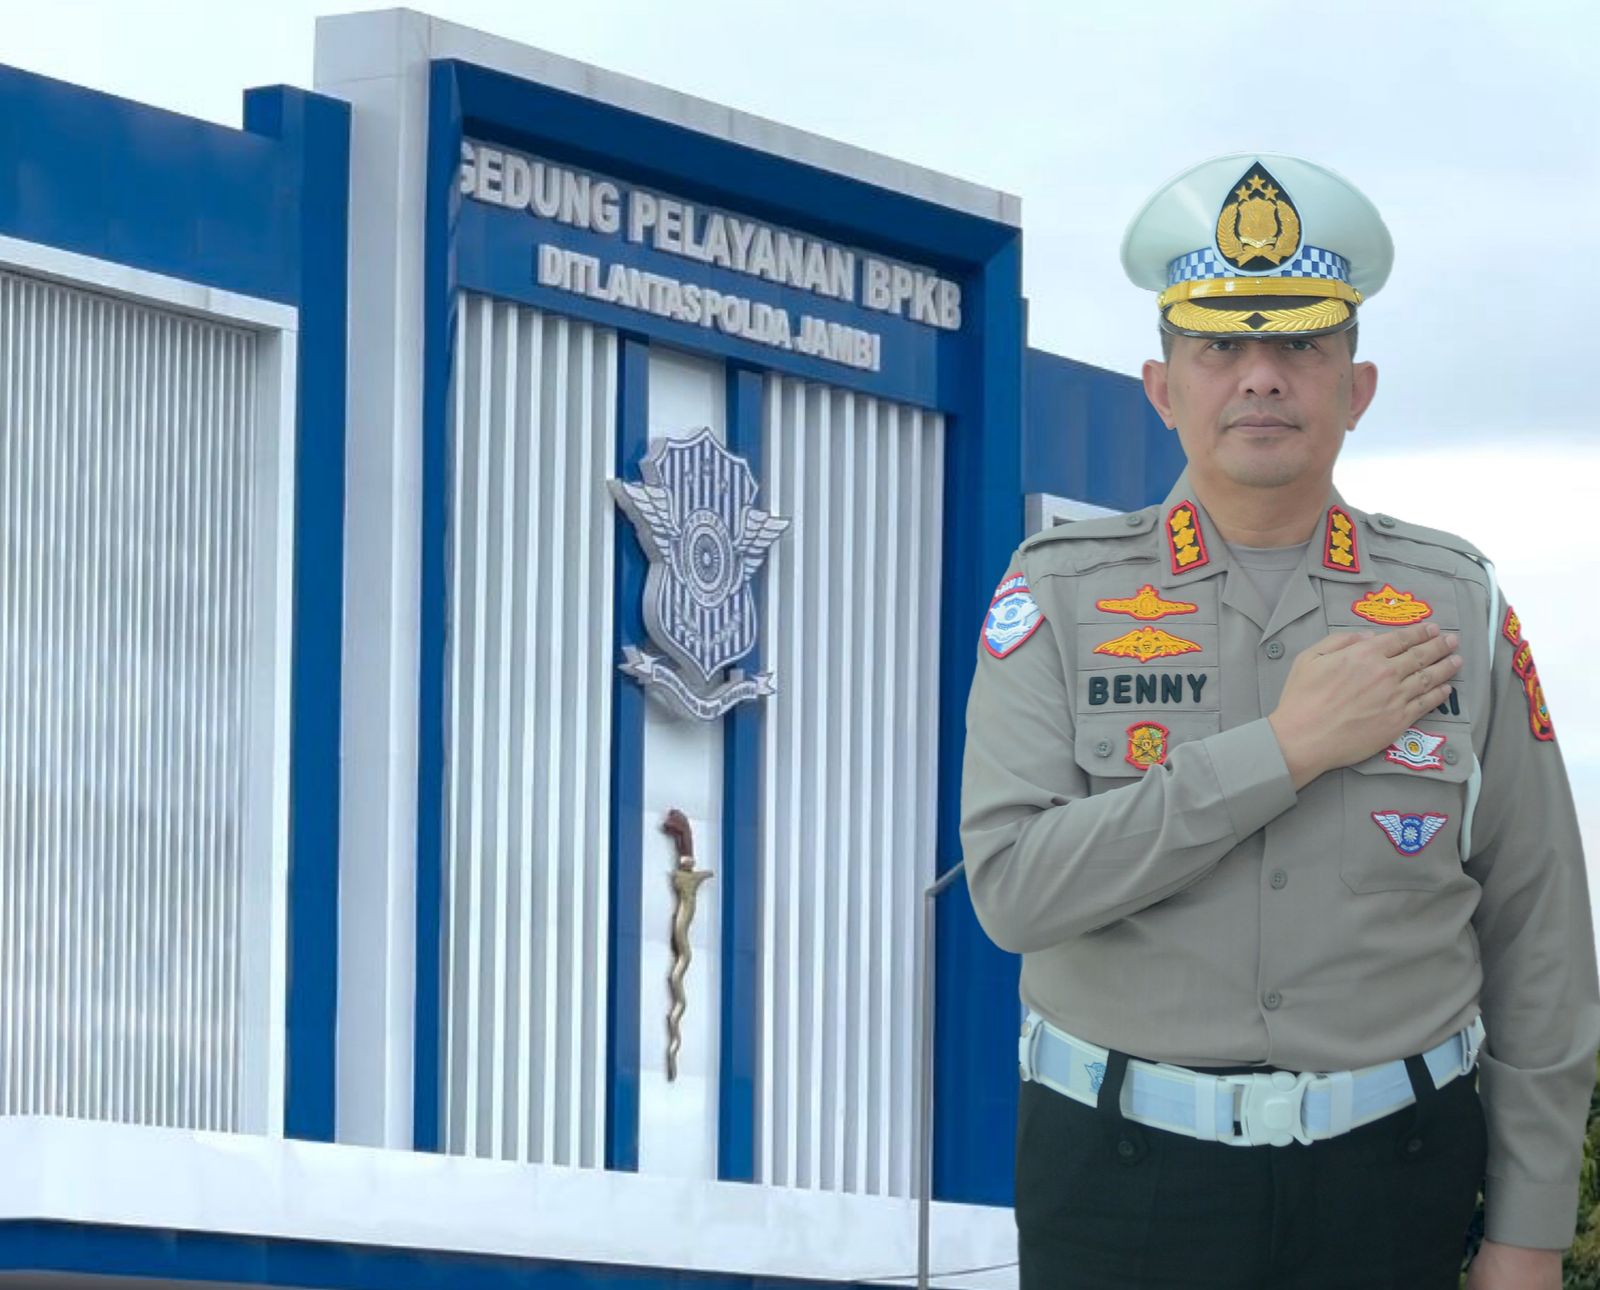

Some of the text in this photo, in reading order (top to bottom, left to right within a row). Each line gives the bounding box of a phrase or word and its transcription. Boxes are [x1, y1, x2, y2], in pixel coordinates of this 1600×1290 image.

[627, 189, 855, 301] PELAYANAN
[863, 258, 962, 331] BPKB
[795, 315, 881, 372] JAMBI
[1088, 673, 1207, 706] BENNY
